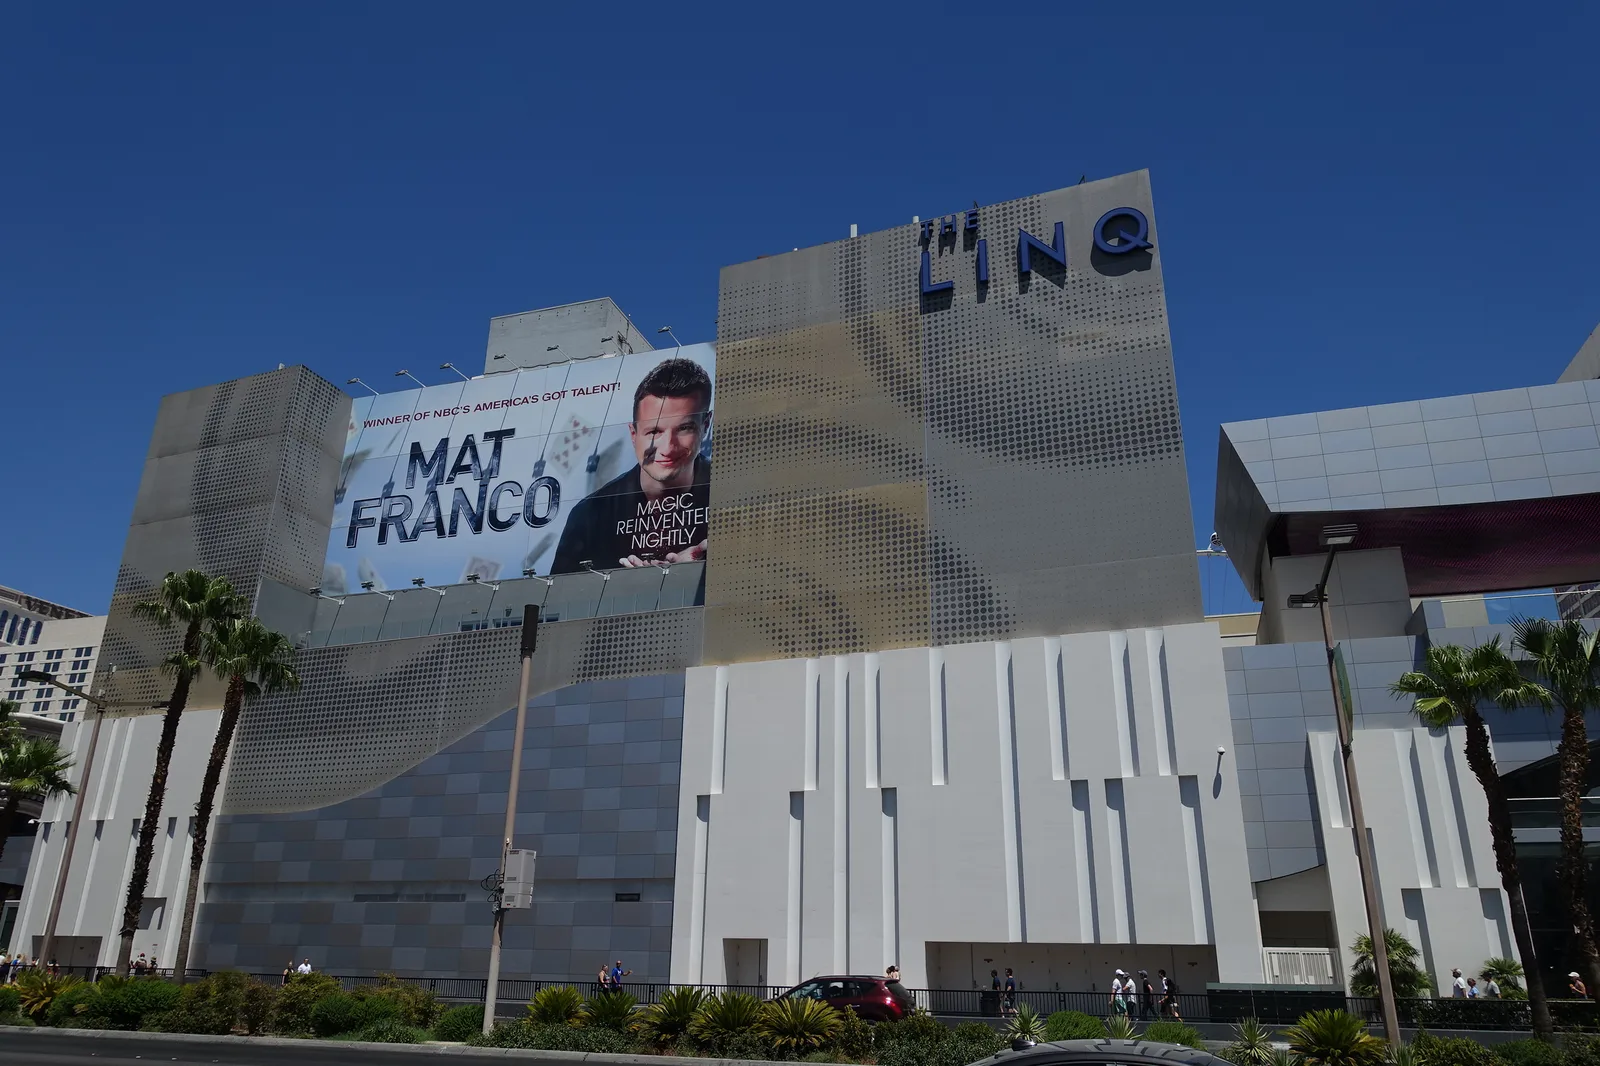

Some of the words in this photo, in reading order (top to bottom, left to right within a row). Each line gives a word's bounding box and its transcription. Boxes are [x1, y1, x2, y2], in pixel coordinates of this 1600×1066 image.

[920, 209, 979, 239] THE
[920, 206, 1154, 294] LINQ
[363, 414, 411, 429] WINNER
[413, 411, 431, 421] OF
[433, 405, 471, 419] NBC'S
[473, 395, 539, 413] AMERICA'S
[542, 390, 569, 402] GOT
[571, 382, 621, 397] TALENT!
[405, 427, 516, 490] MAT
[346, 475, 562, 549] FRANCO
[637, 492, 694, 517] MAGIC
[631, 527, 697, 549] NIGHTLY
